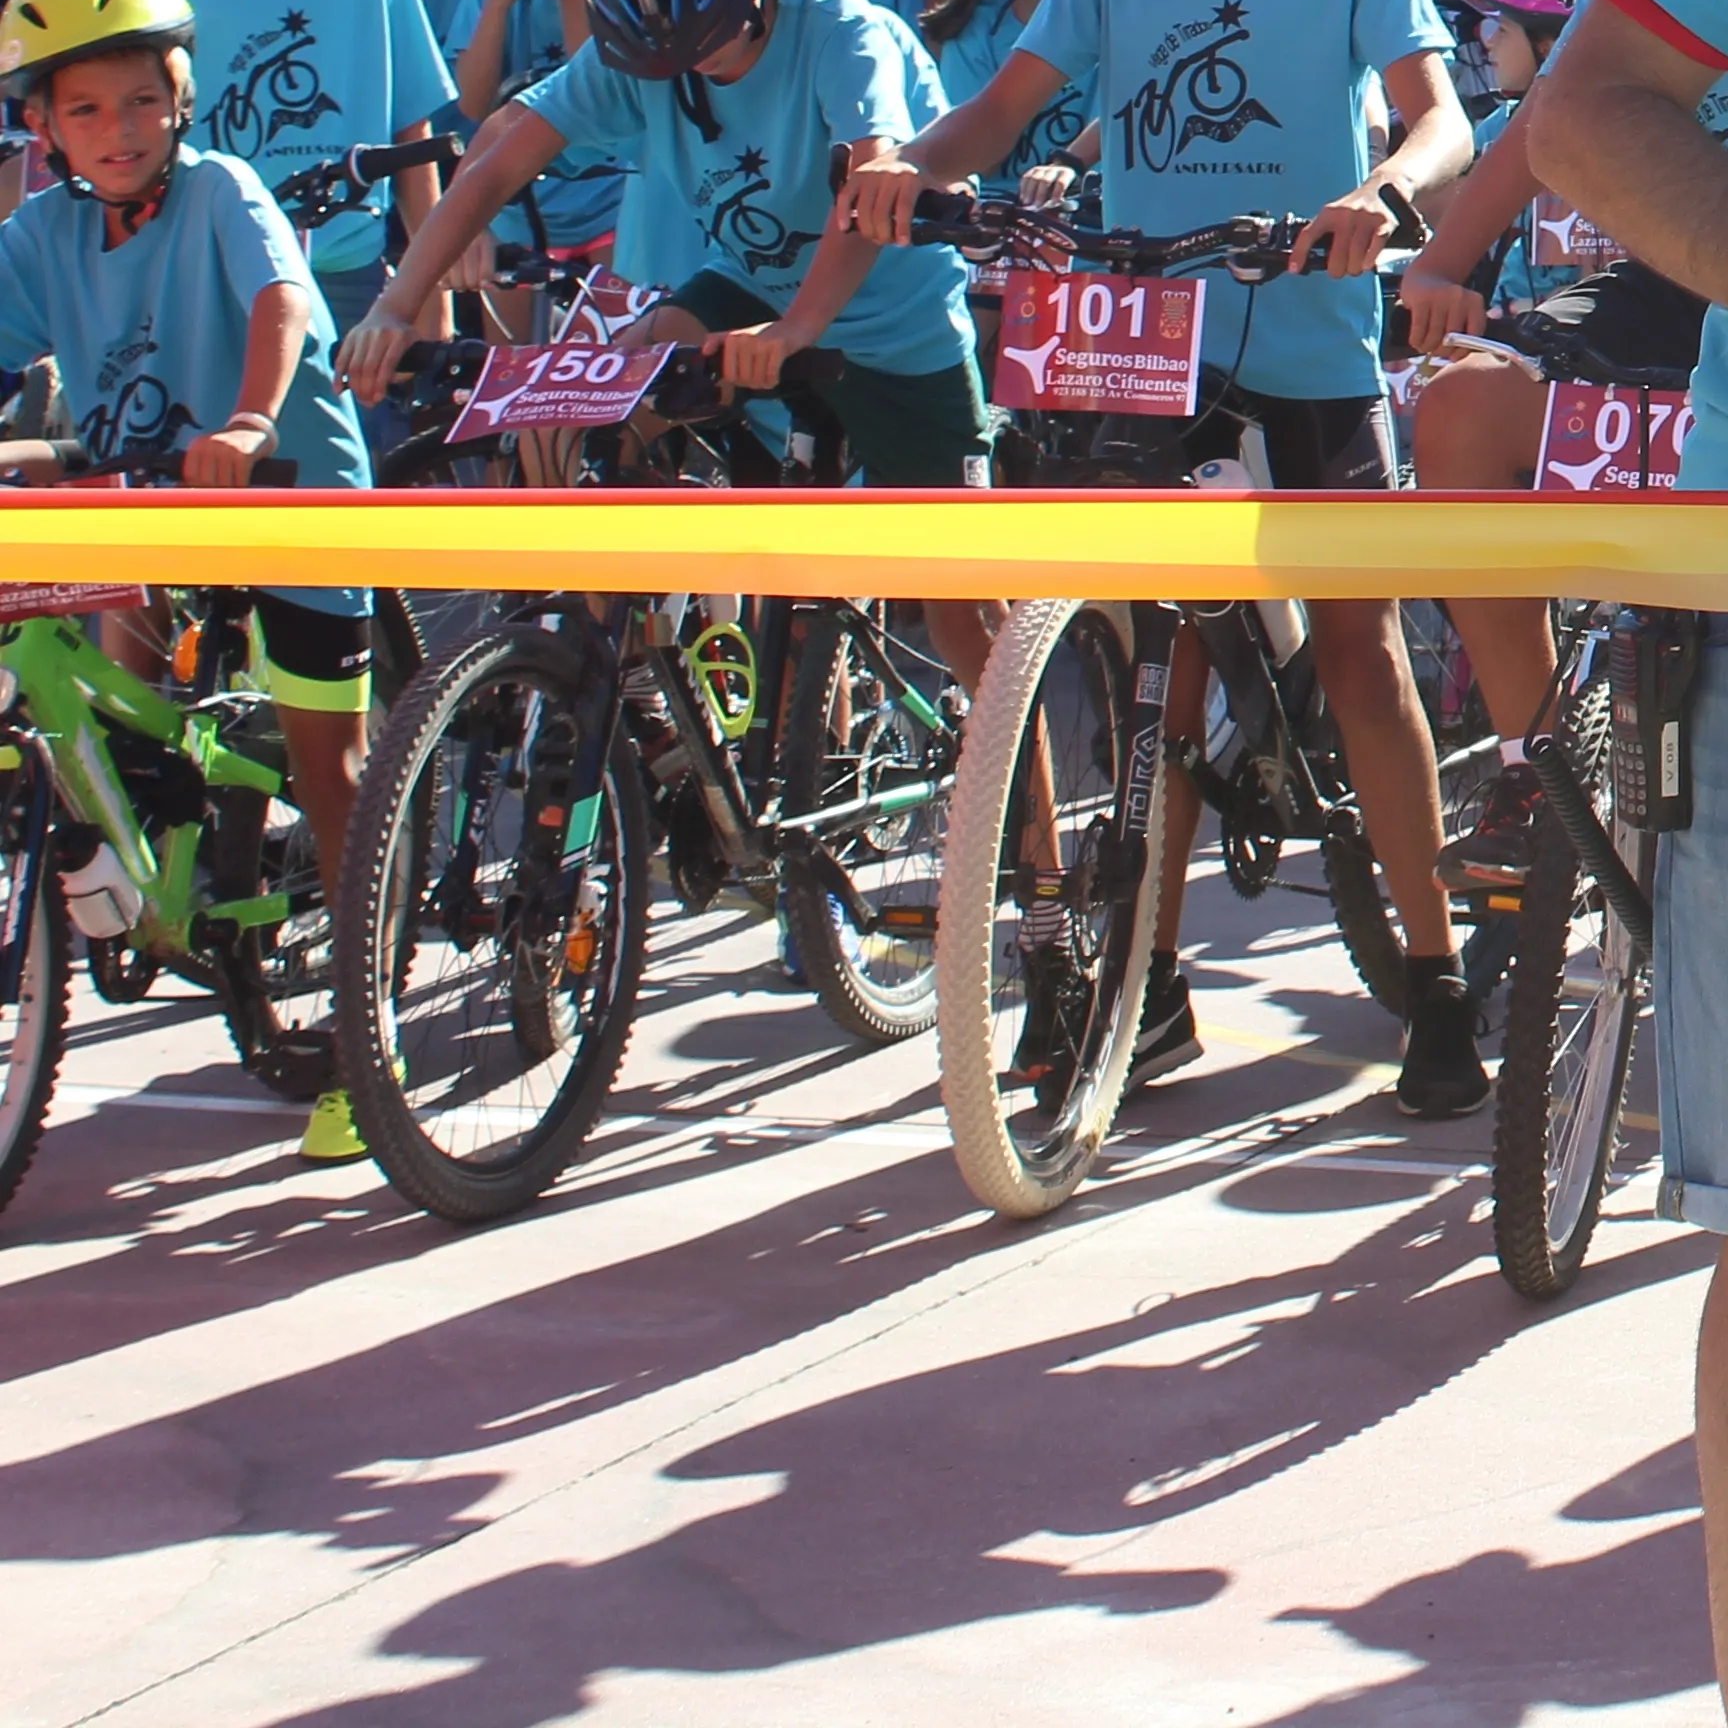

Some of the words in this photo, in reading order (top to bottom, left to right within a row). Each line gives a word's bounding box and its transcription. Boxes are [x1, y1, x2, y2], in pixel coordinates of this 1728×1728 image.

[1047, 282, 1147, 338] 101
[526, 350, 626, 385] 150
[1046, 369, 1103, 388] Lazaro
[1106, 373, 1190, 393] Cifuentes
[1089, 388, 1106, 398] 125
[1108, 390, 1121, 399] Av
[502, 403, 555, 418] Lazaro
